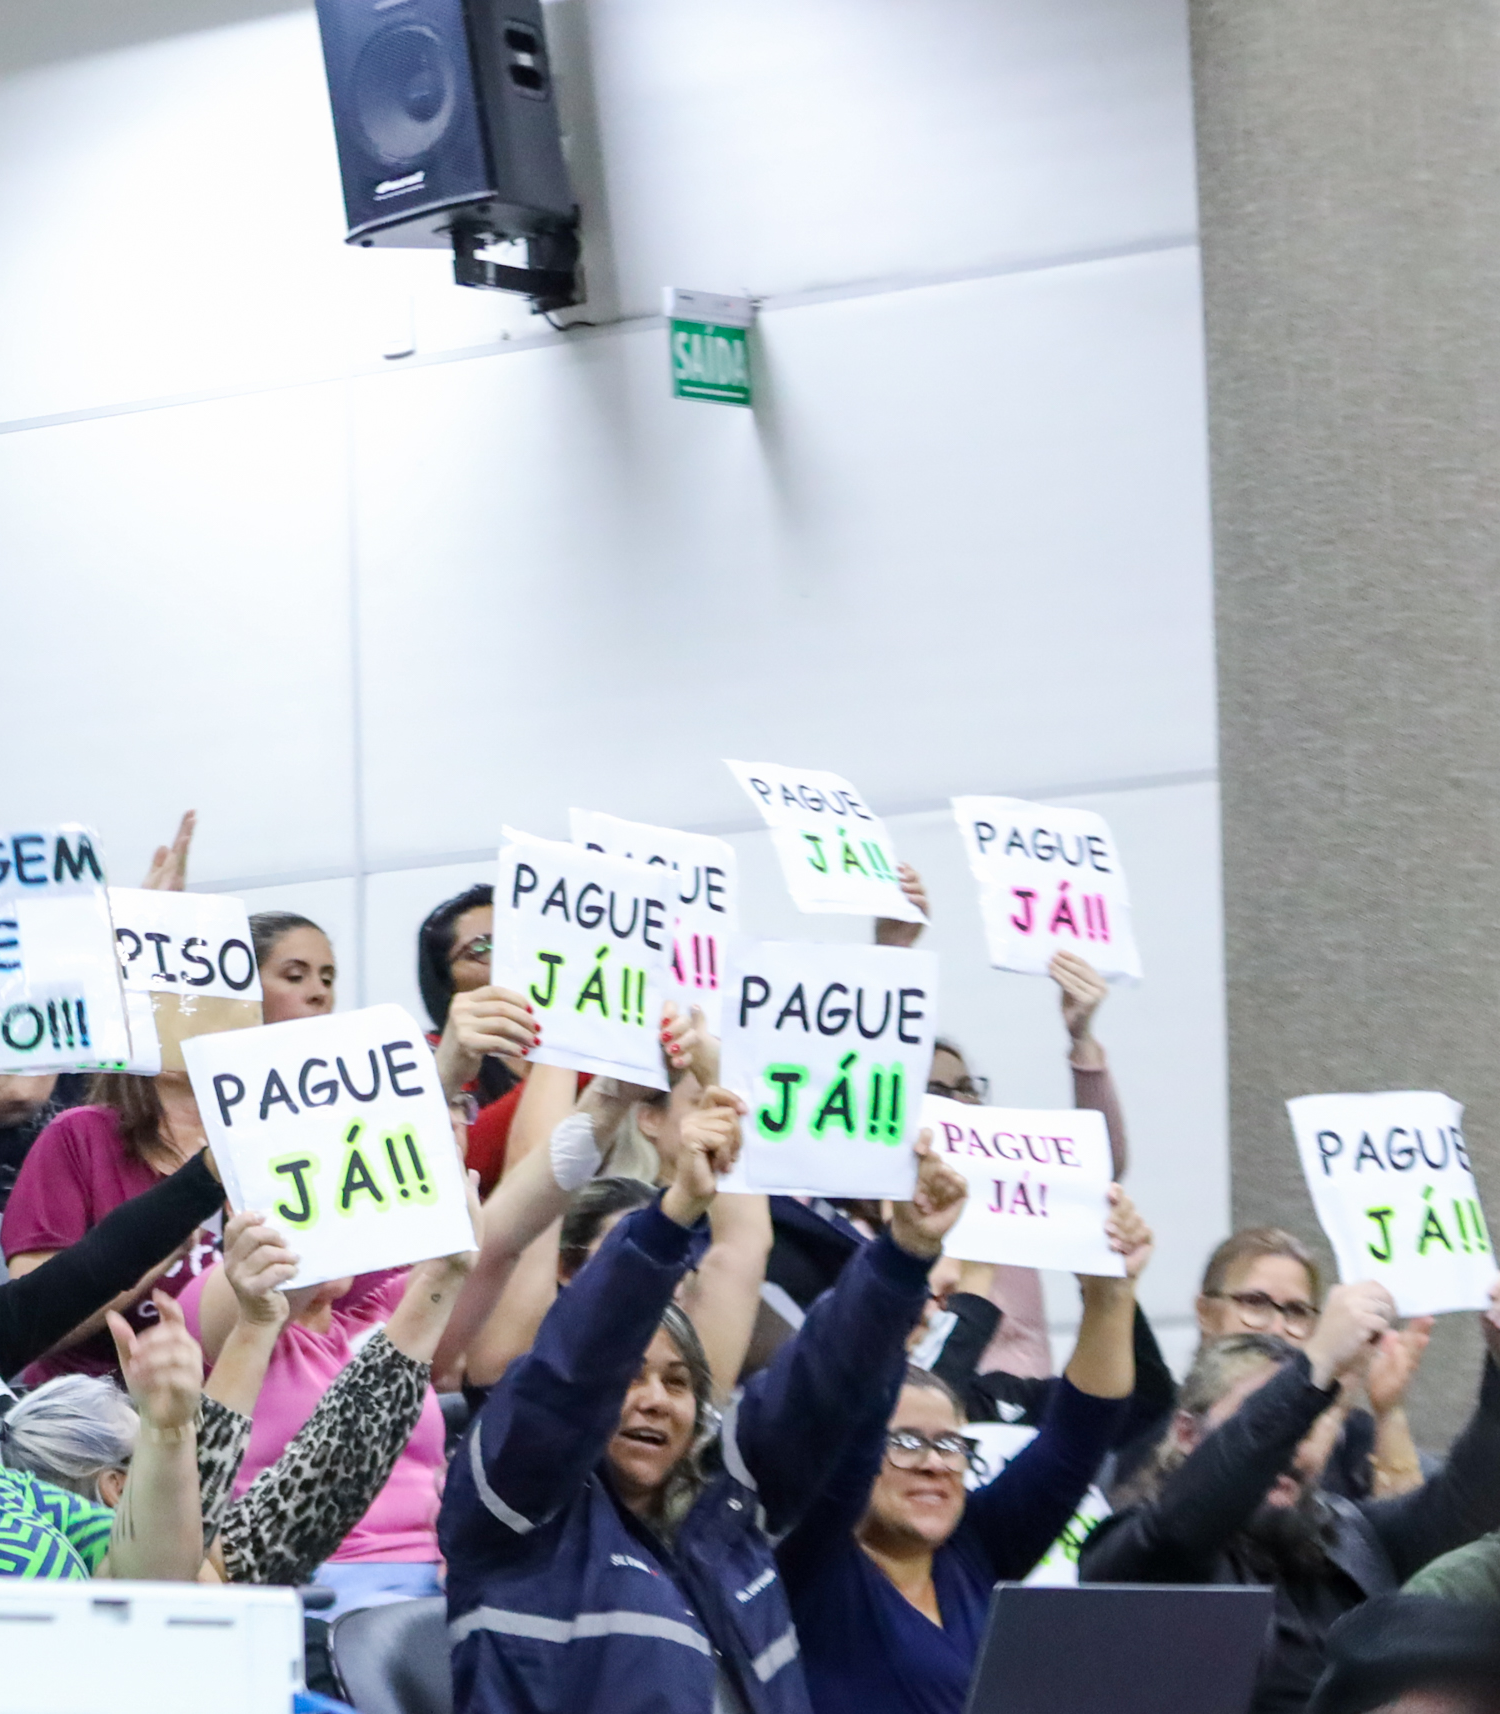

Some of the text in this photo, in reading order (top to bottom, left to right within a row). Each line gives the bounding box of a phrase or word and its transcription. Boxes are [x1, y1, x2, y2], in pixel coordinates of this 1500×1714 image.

[673, 326, 747, 386] SAÍDA
[750, 778, 874, 820] PAGUE
[802, 828, 897, 881] JÁ!!
[974, 821, 1112, 873] PAGUE
[512, 863, 666, 951] PAGUE
[1010, 880, 1110, 943] JÁ!!
[115, 928, 255, 991] PISO
[528, 945, 647, 1027] JÁ!!
[739, 976, 926, 1044] PAGUE
[212, 1040, 425, 1127] PAGUE
[759, 1052, 903, 1137] JÁ!!
[274, 1123, 431, 1224] JÁ!!
[940, 1122, 1080, 1167] PAGUE
[988, 1171, 1048, 1218] JÁ!
[1366, 1185, 1489, 1263] JÁ!!
